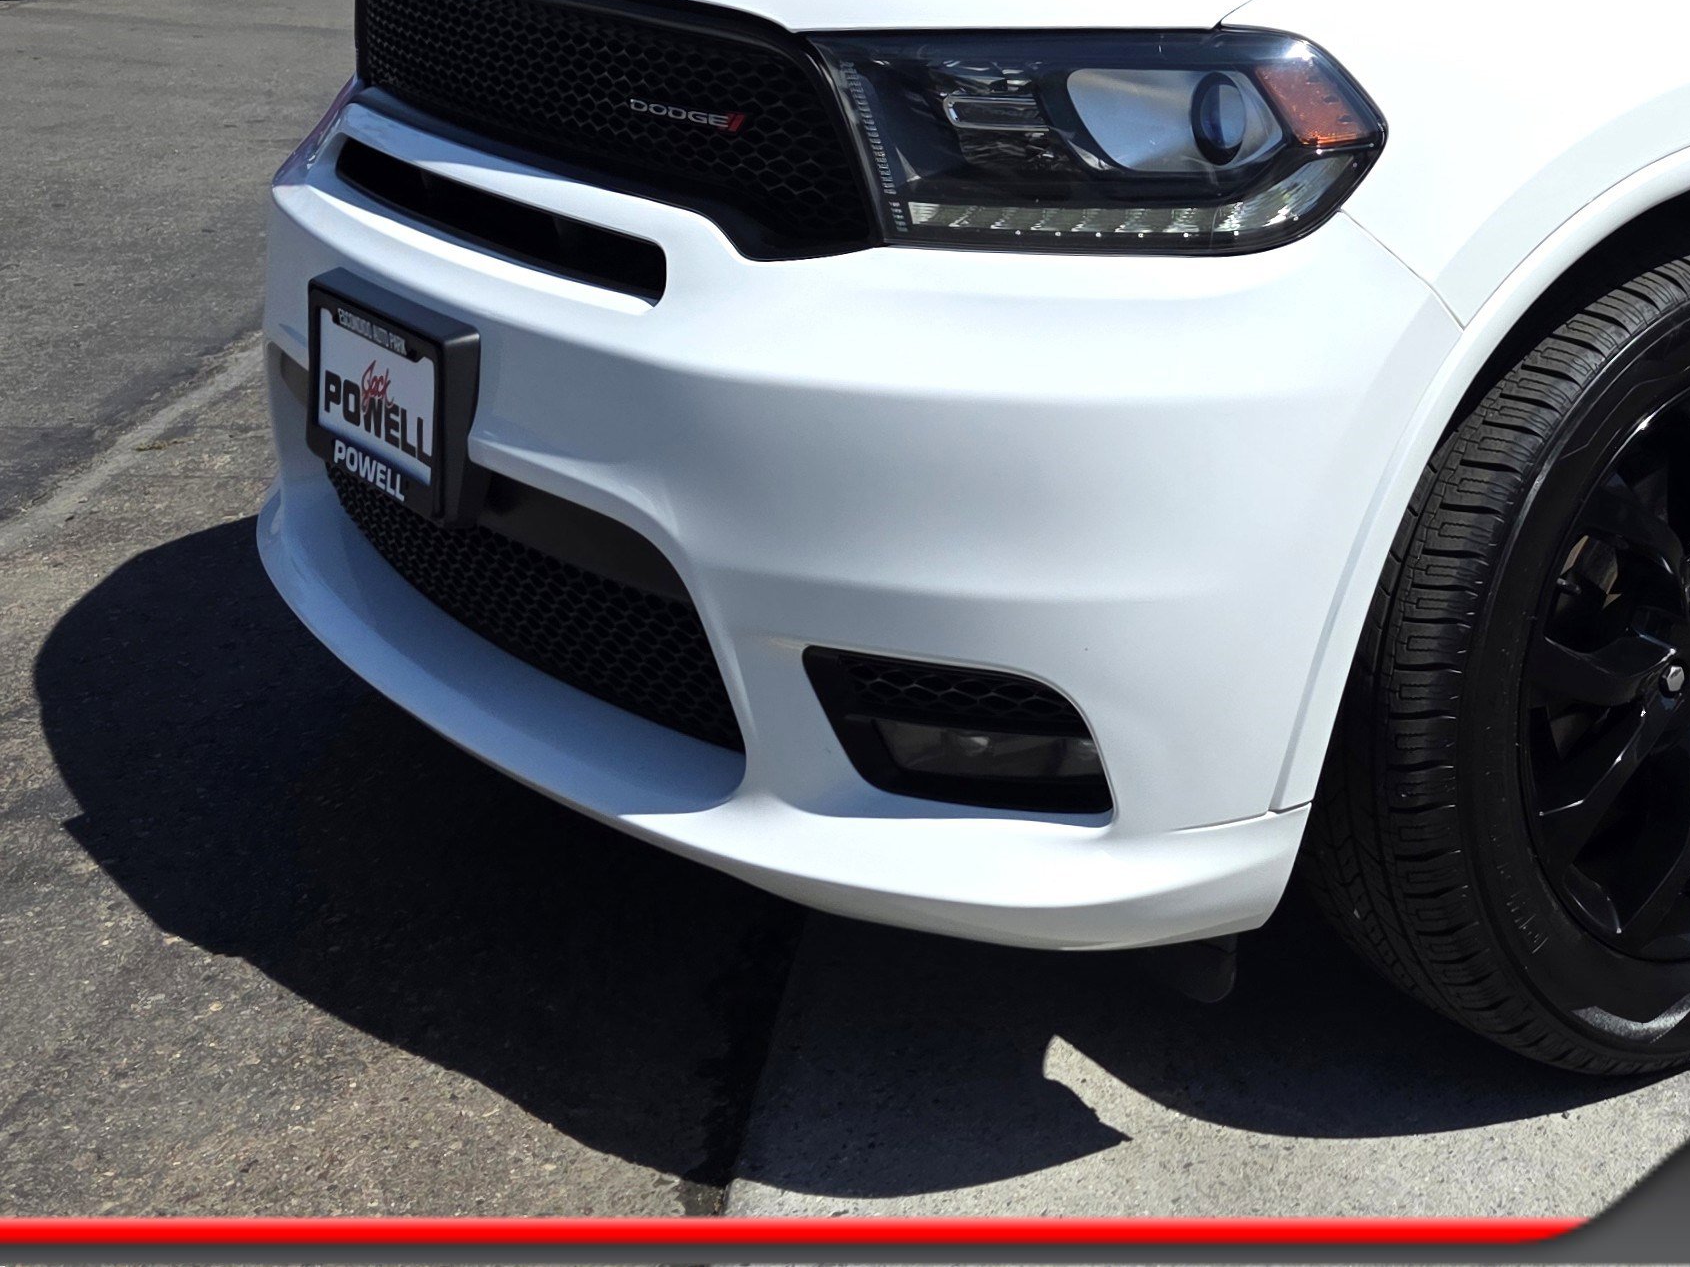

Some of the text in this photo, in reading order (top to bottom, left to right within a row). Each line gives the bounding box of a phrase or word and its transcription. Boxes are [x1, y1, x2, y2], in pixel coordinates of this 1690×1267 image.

[629, 98, 729, 128] DODGE
[361, 359, 394, 414] Jack
[324, 369, 433, 466] POWELL
[333, 439, 405, 502] POWELL
